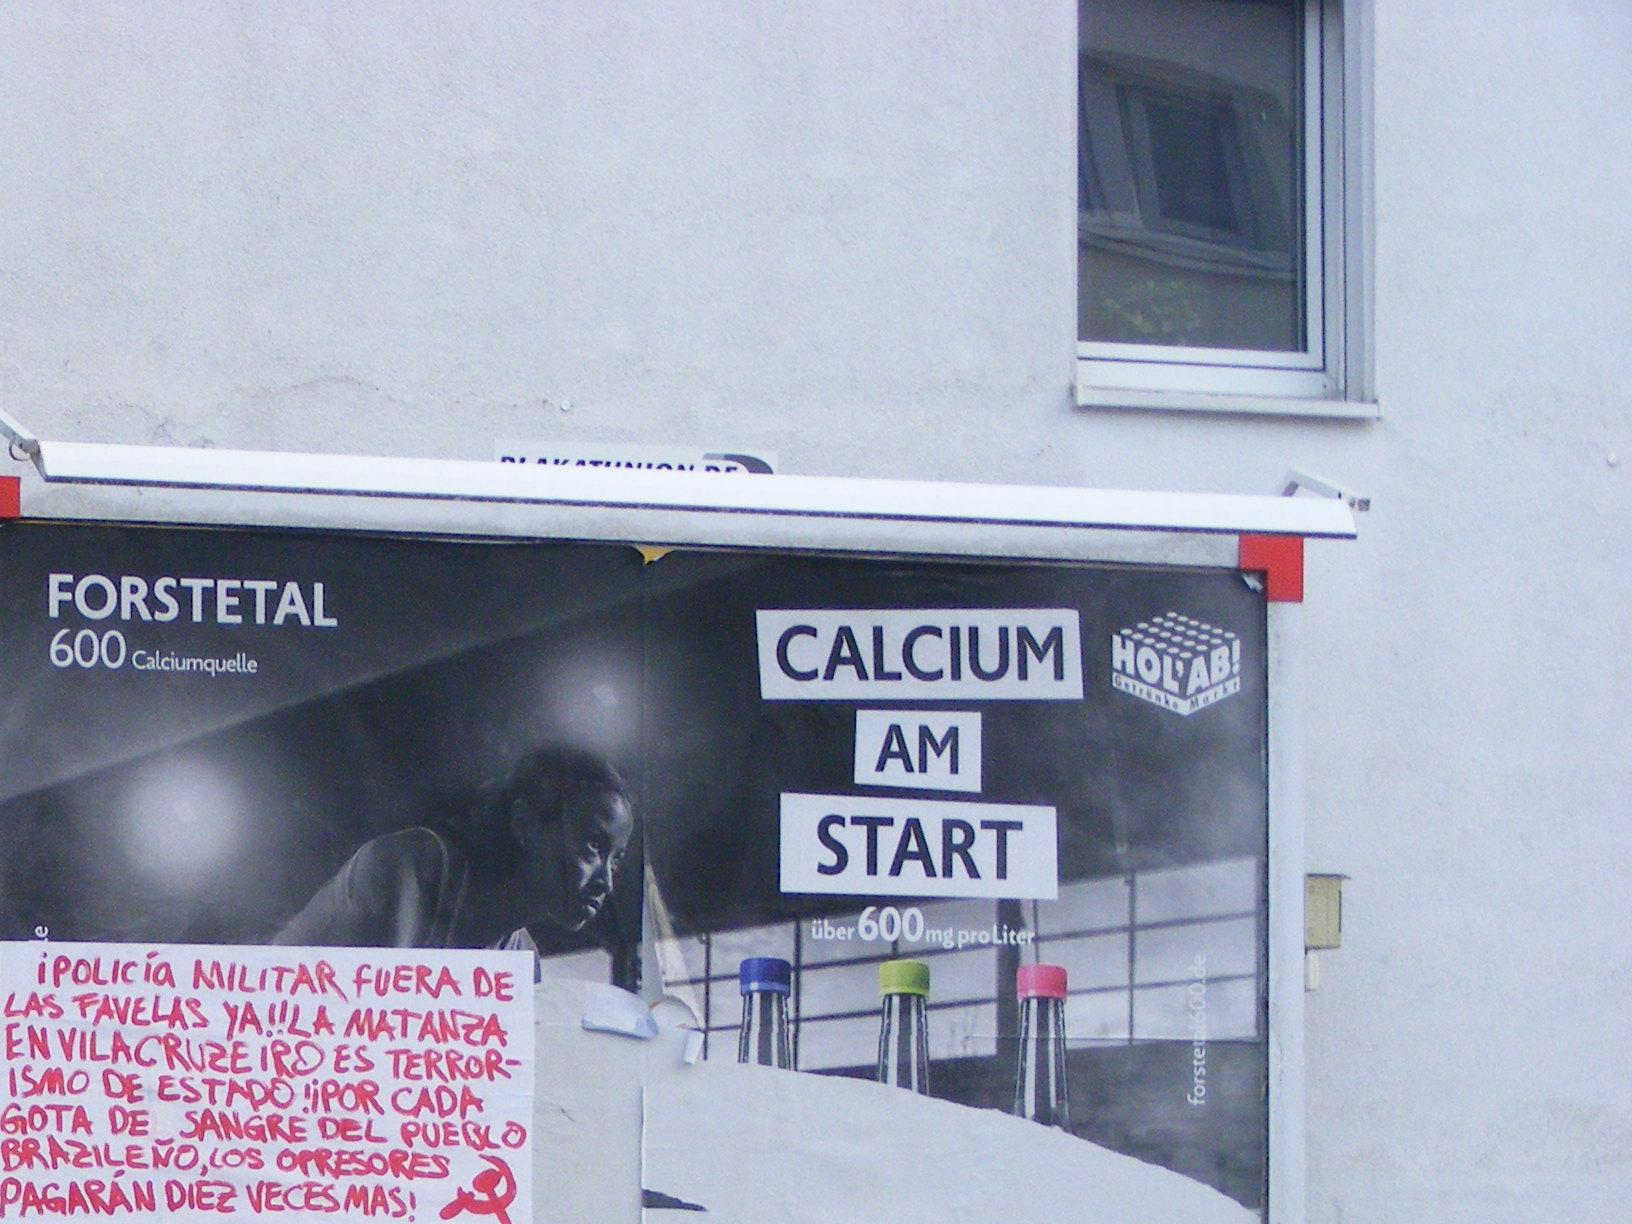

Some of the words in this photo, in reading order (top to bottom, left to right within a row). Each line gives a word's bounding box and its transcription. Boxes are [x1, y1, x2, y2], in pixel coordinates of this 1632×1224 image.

[48, 573, 338, 628] FORSTETAL
[50, 629, 128, 669] 600
[131, 650, 258, 677] Calciumquelle
[775, 624, 1065, 684] CALCIUM
[874, 723, 961, 776] AM
[817, 813, 1024, 881] START
[811, 919, 855, 941] über
[858, 906, 924, 942] 600
[193, 959, 348, 1003] MILITAR
[473, 966, 514, 1001] DE
[3, 991, 64, 1019] LAS
[72, 992, 210, 1031] FAVELAS
[344, 1007, 508, 1047] MATANZA
[5, 1022, 52, 1060] EN
[57, 1027, 132, 1064] VILA
[333, 1044, 375, 1073] ES
[9, 1065, 90, 1098] ISMO
[102, 1068, 144, 1104] DE
[390, 1084, 484, 1119] CADA
[0, 1103, 93, 1136] GOTA
[108, 1104, 149, 1137] DE
[179, 1108, 308, 1144] SANGRE
[318, 1116, 388, 1144] DEL
[400, 1120, 527, 1151] PUEBLO
[276, 1148, 450, 1180] OPRESORES
[0, 1169, 156, 1219] PAGARÁN
[165, 1179, 238, 1213] DIEZ
[246, 1180, 340, 1214] VECES
